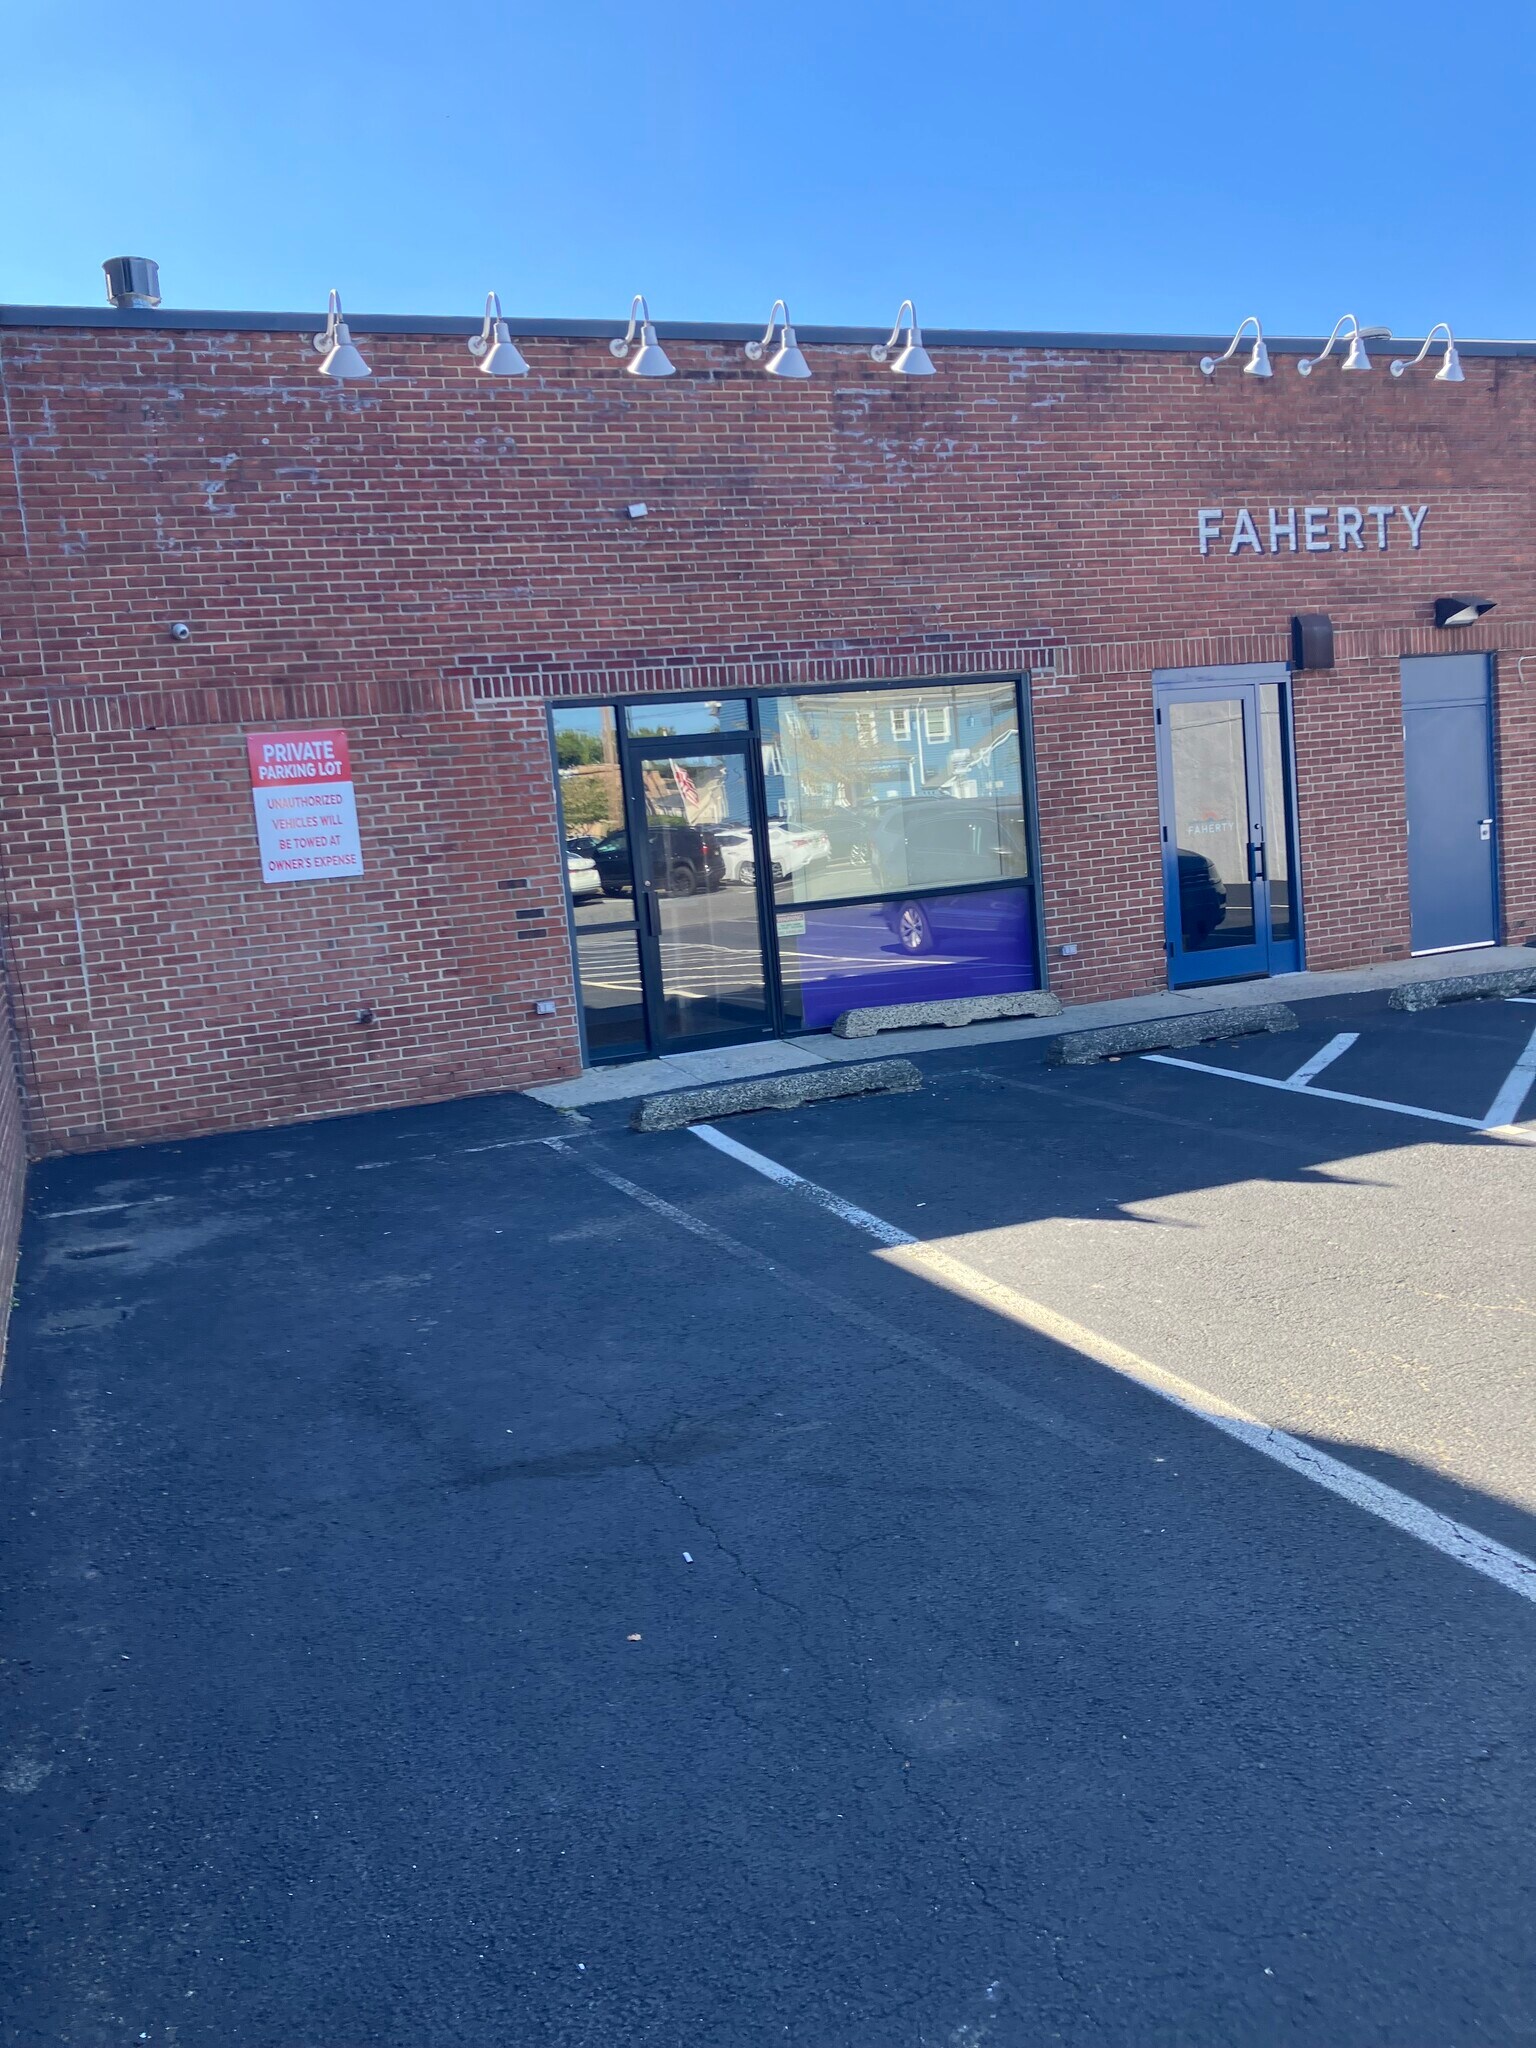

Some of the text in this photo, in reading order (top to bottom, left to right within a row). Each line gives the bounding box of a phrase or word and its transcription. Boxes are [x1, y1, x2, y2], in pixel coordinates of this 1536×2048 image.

[1198, 505, 1428, 554] FAHERTY
[262, 741, 335, 762] PRIVATE
[258, 761, 342, 780] PARKING LOT
[267, 794, 343, 809] UNAUTHORIZED
[272, 814, 343, 830] VEHICLES WILL
[1188, 823, 1234, 834] FAHERTY
[279, 835, 341, 850] BE TOWED AT
[268, 854, 357, 871] OWNER'S EXPENSE
